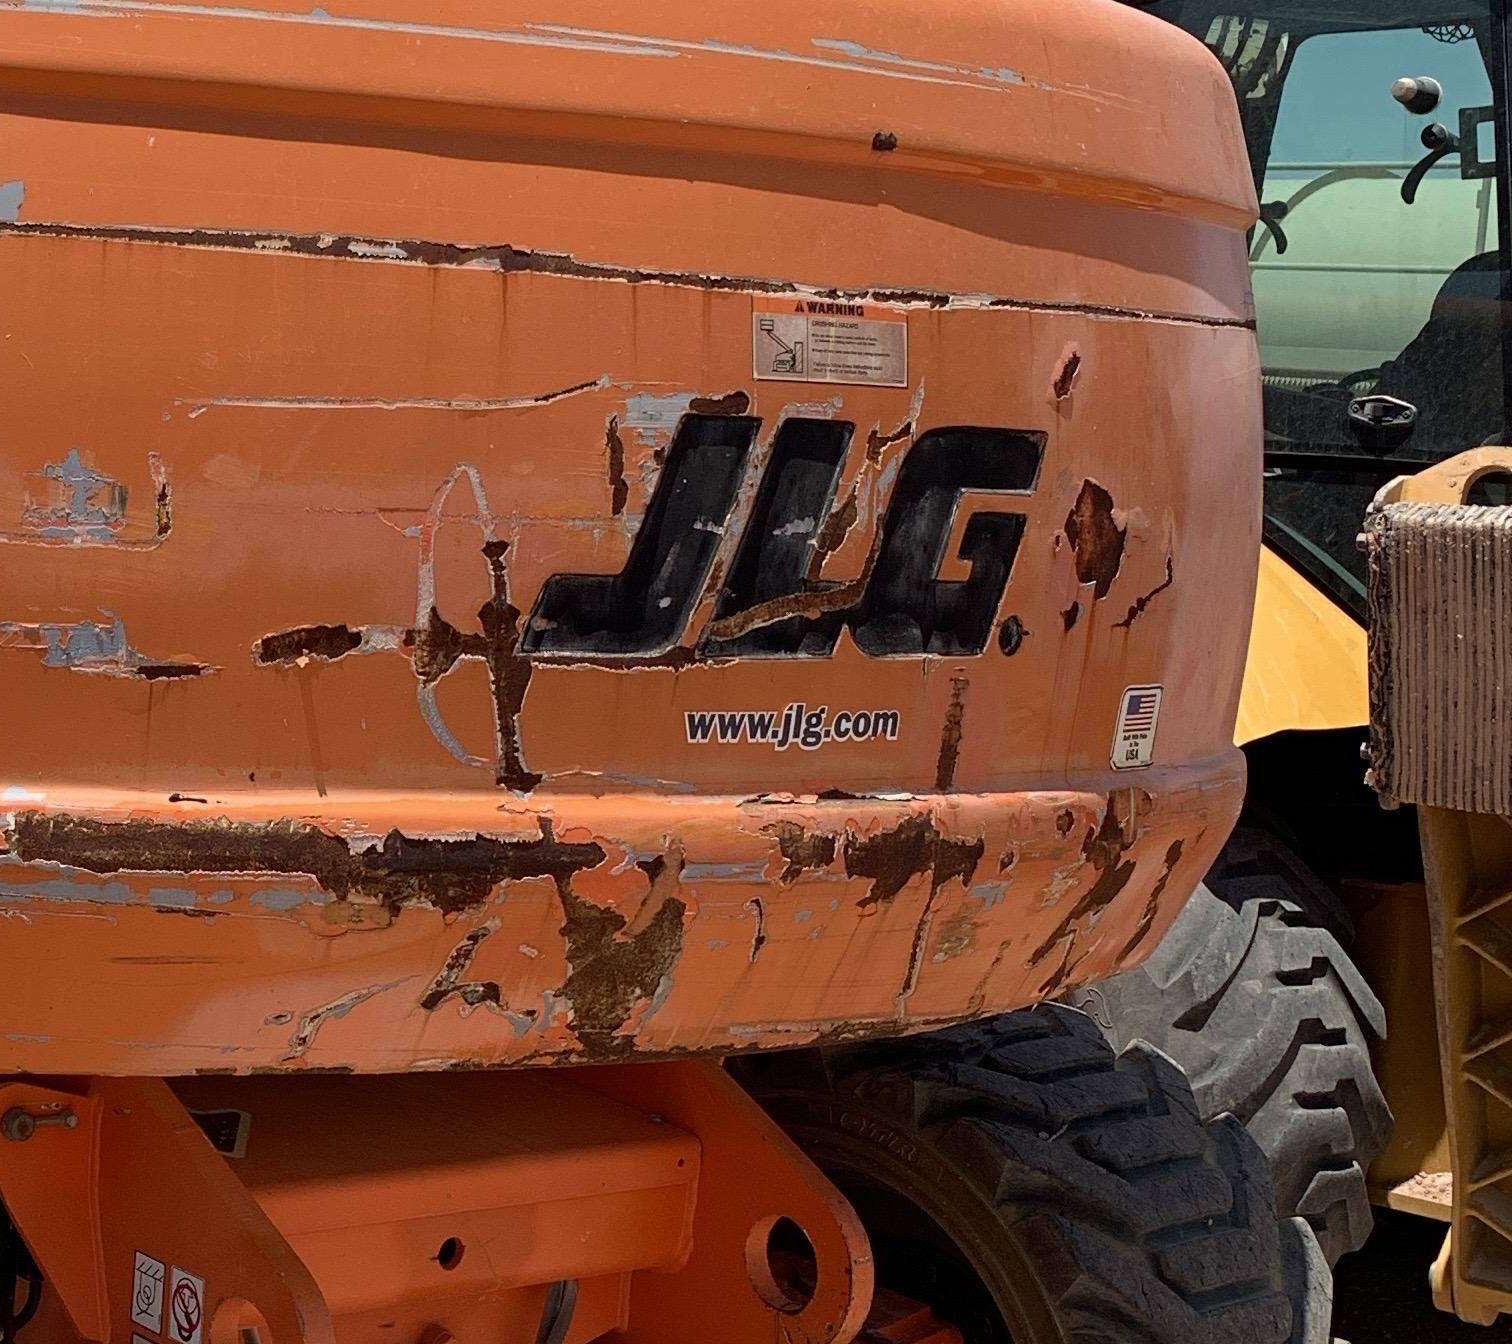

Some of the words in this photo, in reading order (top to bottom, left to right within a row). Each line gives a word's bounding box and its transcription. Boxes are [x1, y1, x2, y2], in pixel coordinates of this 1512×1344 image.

[806, 300, 865, 317] WARNING
[685, 704, 900, 750] www.jlg.com
[1125, 748, 1139, 761] USA
